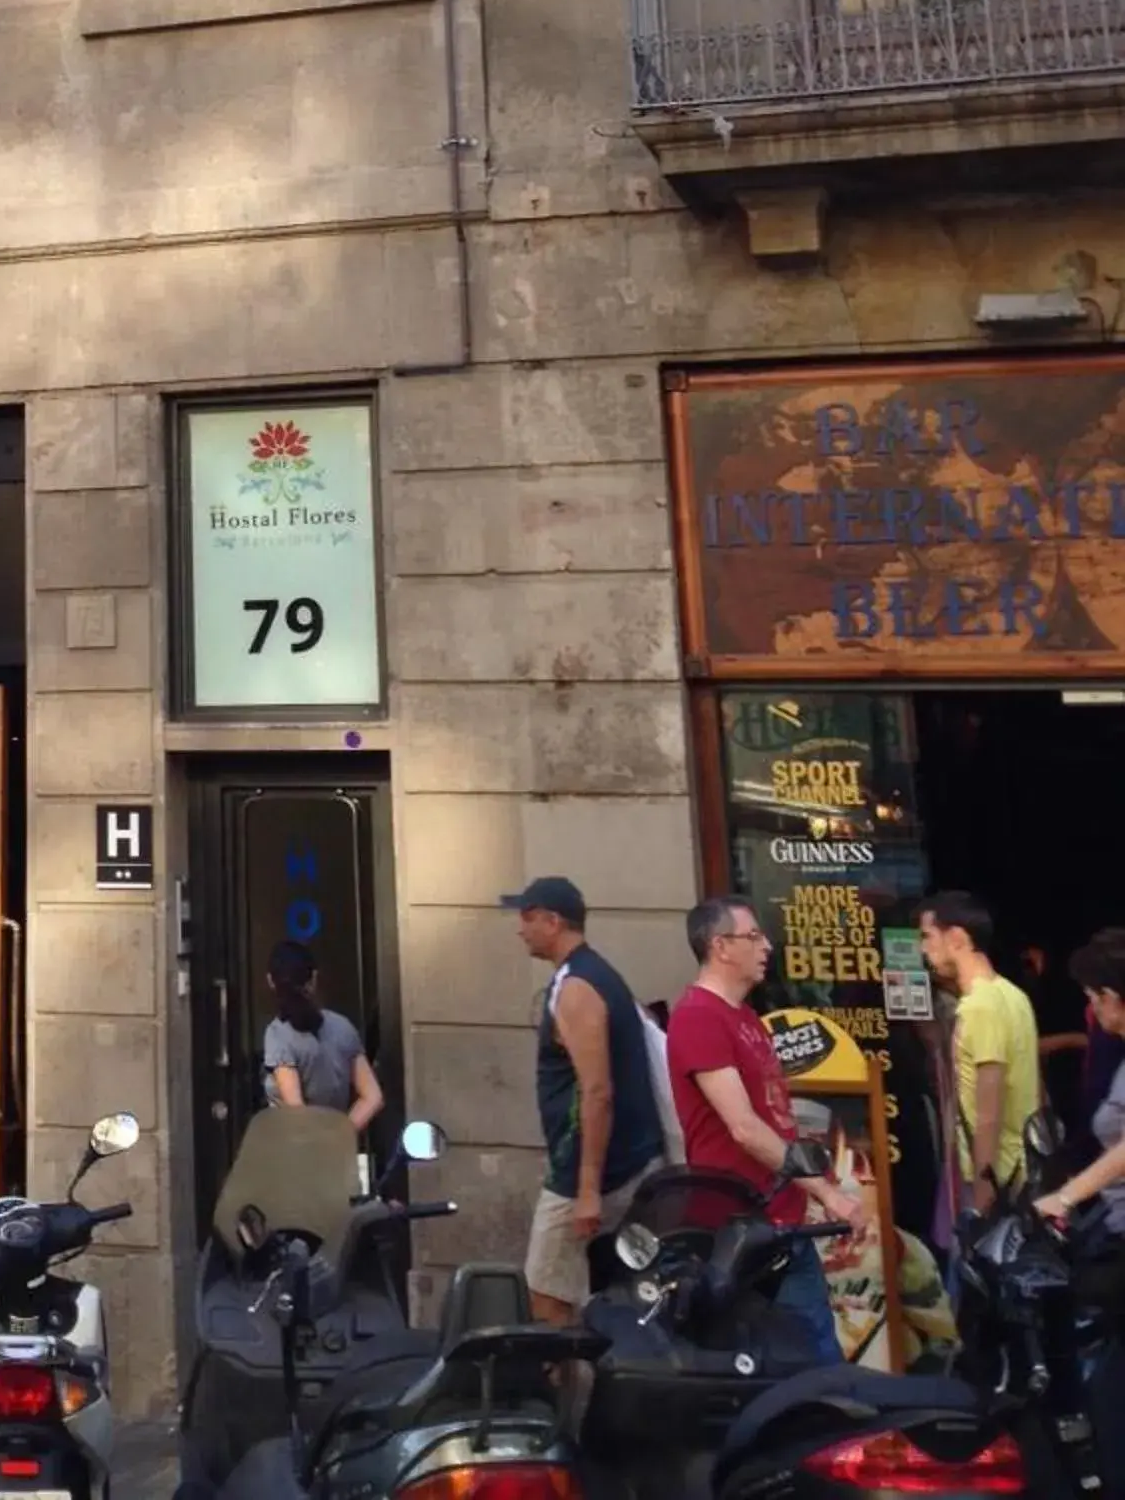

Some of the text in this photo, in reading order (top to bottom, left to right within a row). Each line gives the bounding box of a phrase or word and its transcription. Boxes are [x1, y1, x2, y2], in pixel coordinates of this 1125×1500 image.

[816, 402, 985, 457] BAR
[210, 507, 357, 530] Hostal Flores
[834, 578, 1048, 639] BEER
[243, 597, 323, 654] 79
[772, 761, 861, 785] SPORT
[774, 783, 866, 805] CHANNEL
[106, 812, 140, 857] H
[770, 837, 875, 863] GUINNESS
[793, 885, 860, 906] MORE
[781, 904, 875, 927] THAN 30
[784, 926, 875, 947] TYPES OF
[785, 946, 882, 981] BEER
